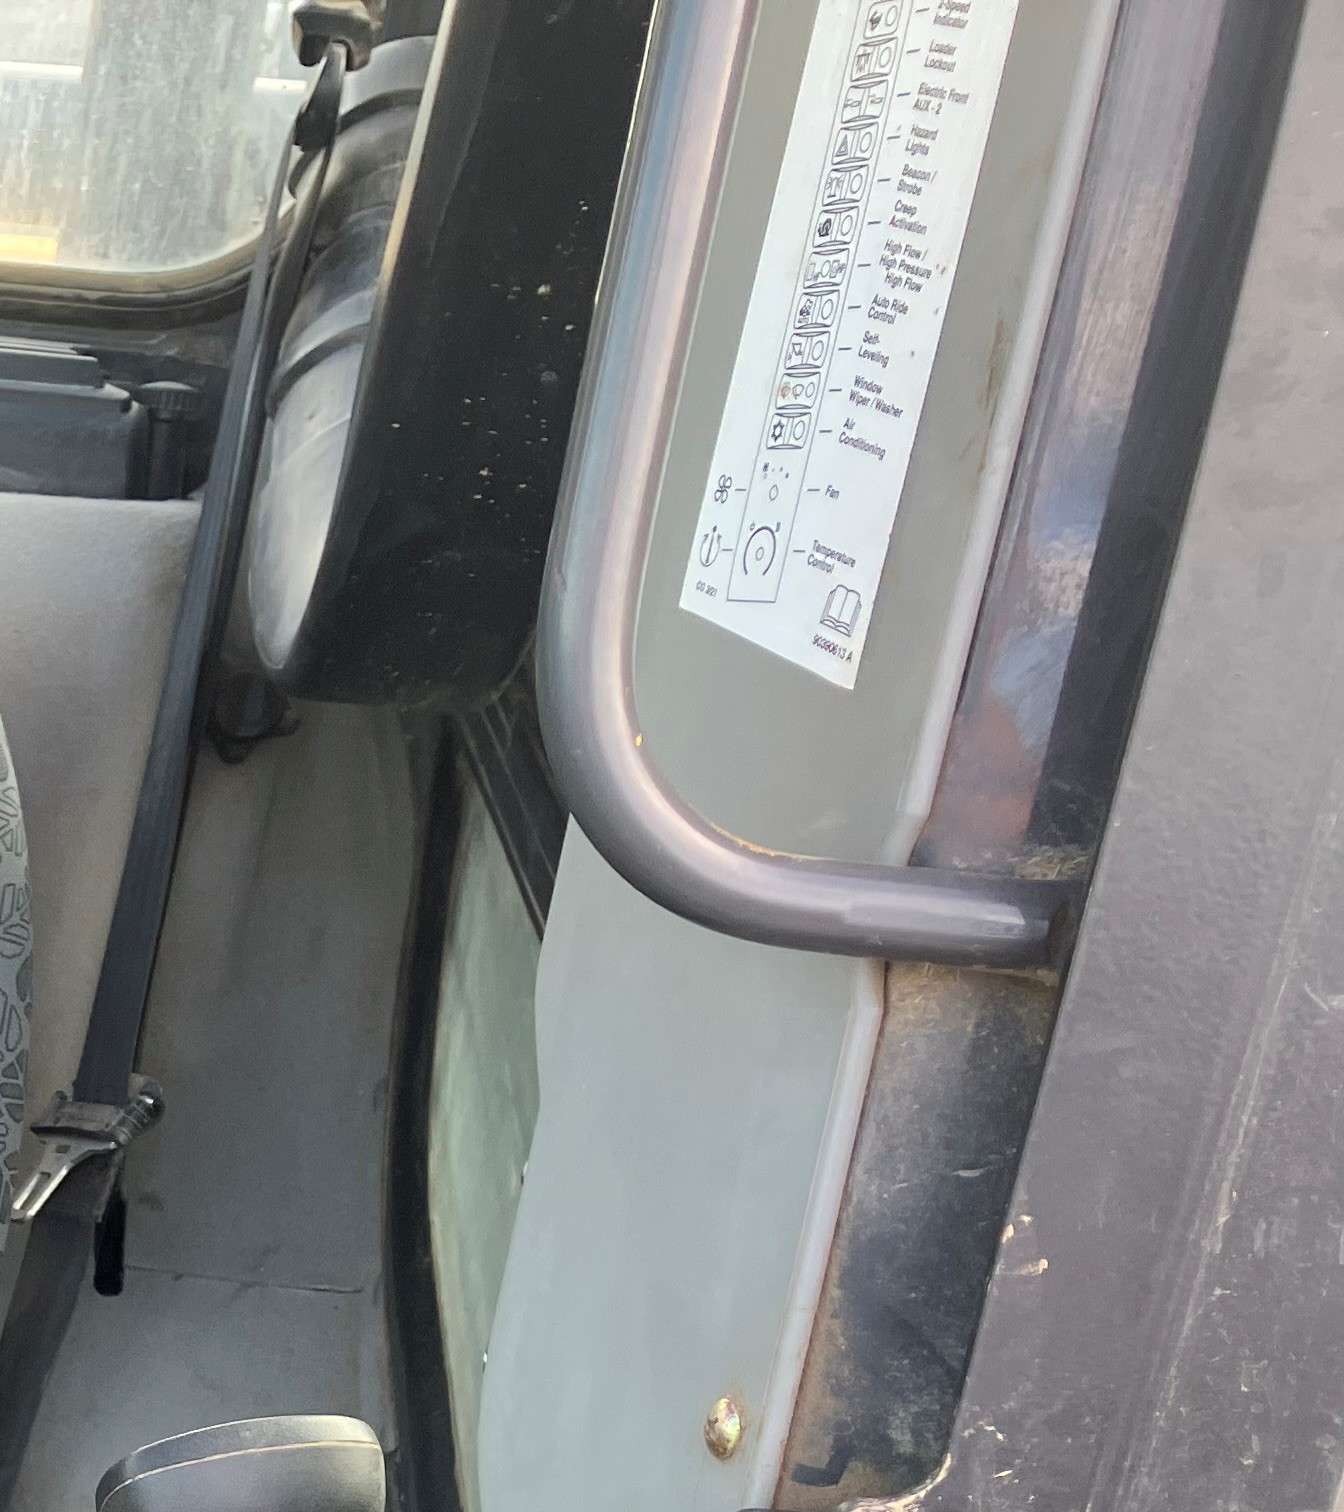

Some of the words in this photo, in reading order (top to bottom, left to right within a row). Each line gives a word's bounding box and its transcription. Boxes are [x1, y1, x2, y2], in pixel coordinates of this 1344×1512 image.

[933, 12, 968, 29] Indicator
[929, 39, 957, 55] Loader
[924, 54, 956, 72] Lockout
[918, 82, 948, 99] Electric
[948, 88, 969, 104] Front
[913, 97, 931, 112] AUX
[935, 102, 942, 114] 2
[911, 124, 939, 140] Hazard
[905, 139, 930, 156] Lights
[902, 164, 930, 181] Beacon
[897, 179, 922, 196] Strobe
[895, 200, 917, 217] Creep
[889, 215, 927, 235] Activation
[884, 238, 902, 255] High
[903, 244, 922, 259] Flow
[879, 254, 897, 270] High
[897, 259, 932, 279] Pressure
[884, 272, 902, 288] High
[902, 278, 923, 293] Flow
[871, 293, 890, 309] Auto
[890, 299, 909, 314] Ride
[867, 307, 897, 325] Control
[858, 344, 890, 368] Leveling
[854, 375, 883, 395] Window
[849, 389, 870, 407] Wiper
[875, 398, 904, 418] Washer
[843, 417, 856, 430] Air
[838, 432, 887, 460] Conditioning
[824, 485, 840, 500] Fan
[812, 539, 856, 568] Temperature
[807, 555, 835, 574] Control
